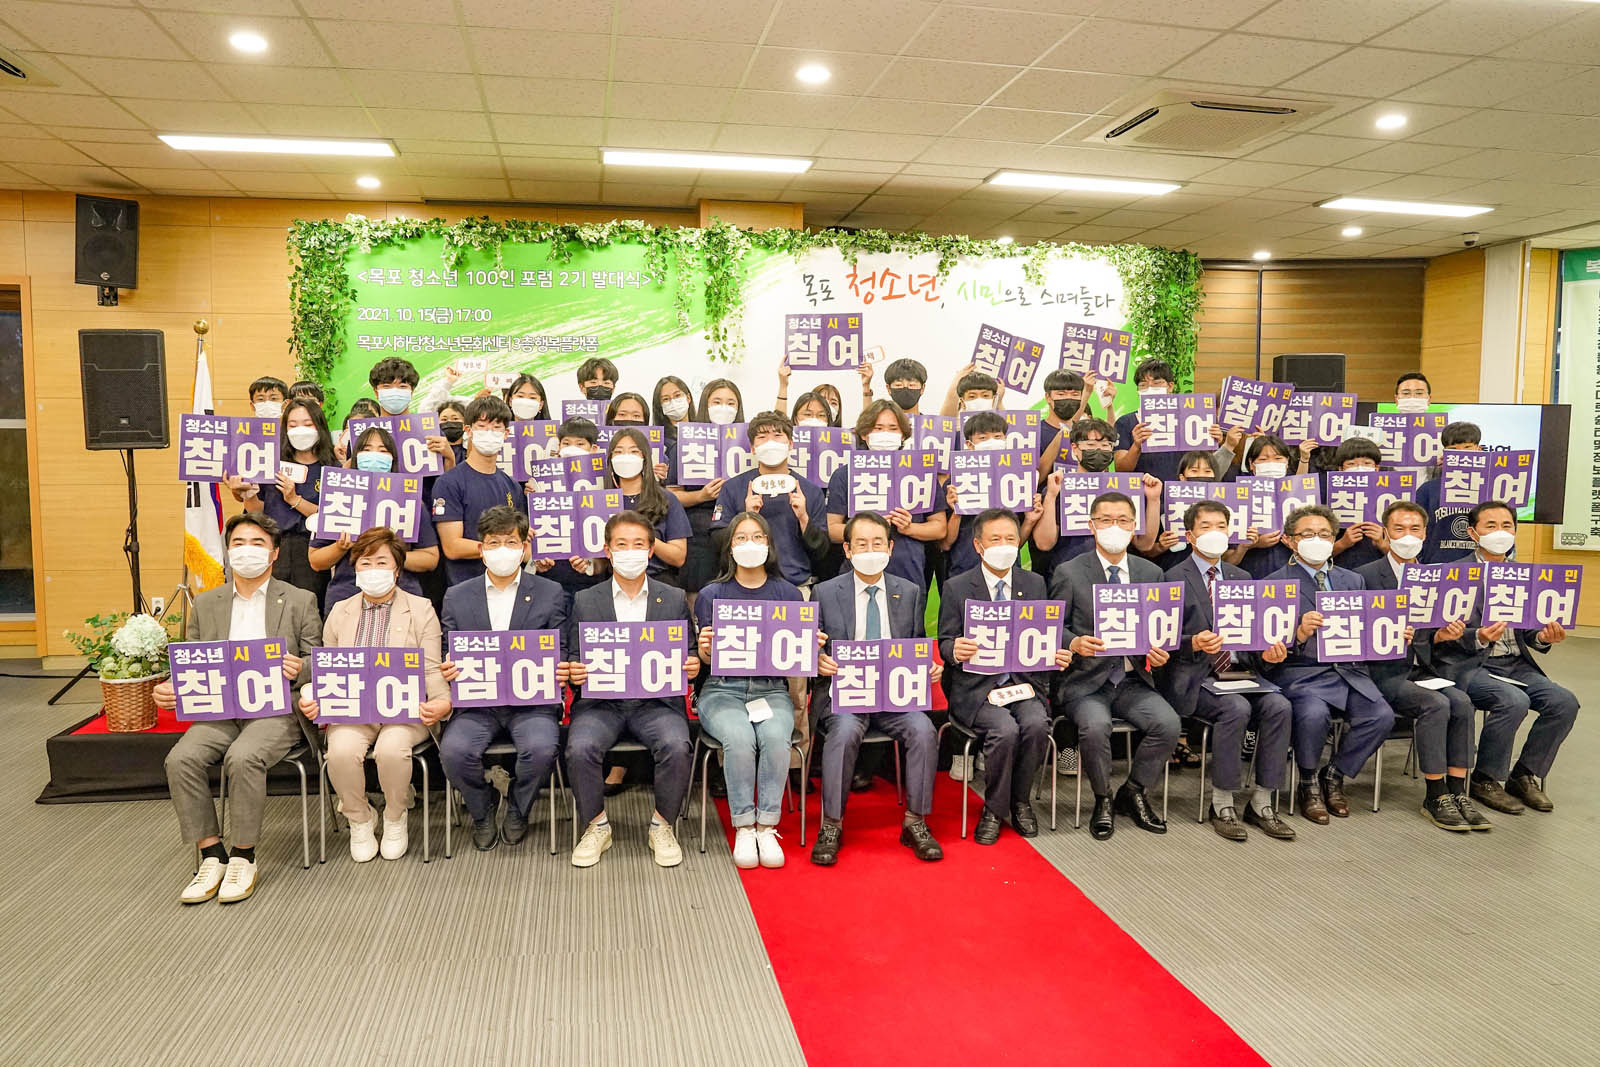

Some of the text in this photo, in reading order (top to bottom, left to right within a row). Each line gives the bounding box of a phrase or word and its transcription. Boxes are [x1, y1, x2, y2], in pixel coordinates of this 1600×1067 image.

[356, 267, 652, 289] <목포 청소년 100인 포럼 2기 발대식>
[803, 264, 1115, 317] 목포 청소년, 시민으로 스며들다
[357, 307, 492, 324] 2021. 10. 15(금) 17:00
[788, 317, 822, 330] 청소년
[982, 328, 1010, 347] 청소년
[1066, 326, 1098, 340] 청소년
[787, 333, 859, 367] 참여
[974, 343, 1037, 391] 참여
[1062, 340, 1127, 380] 참여
[1231, 380, 1264, 396] 청소년
[565, 403, 599, 415] 청소년
[1143, 397, 1178, 410] 청소년
[1289, 395, 1313, 407] 소년
[1223, 394, 1287, 433] 참여
[1373, 415, 1407, 428] 청소년
[185, 419, 228, 435] 청소년
[682, 426, 718, 440] 청소년
[1144, 413, 1215, 448] 참여
[1282, 409, 1352, 443] 참여
[184, 437, 275, 481] 참여
[853, 455, 892, 469] 청소년
[954, 454, 991, 468] 청소년
[1446, 455, 1486, 468] 청소년
[531, 462, 565, 477] 청소년
[326, 471, 369, 490] 청소년
[1064, 477, 1100, 490] 청소년
[1331, 475, 1369, 488] 청소년
[1444, 469, 1528, 505] 참여
[852, 471, 934, 511] 참여
[955, 471, 1032, 510] 참여
[1168, 485, 1206, 498] 청소년
[532, 492, 574, 511] 청소년
[322, 491, 417, 538] 참여
[1406, 566, 1441, 583] 청소년
[1490, 566, 1530, 582] 청소년
[1098, 588, 1139, 604] 청소년
[1218, 584, 1255, 600] 청소년
[1320, 595, 1363, 611] 청소년
[1408, 584, 1478, 623] 참여
[1488, 585, 1576, 626] 참여
[717, 604, 762, 621] 청소년
[969, 605, 1011, 621] 청소년
[1099, 607, 1180, 649] 참여
[1217, 603, 1296, 645] 참여
[453, 635, 501, 652] 청소년
[583, 627, 630, 644] 청소년
[1322, 615, 1407, 657] 참여
[716, 625, 813, 673] 참여
[836, 645, 880, 661] 청소년
[968, 625, 1058, 668] 참여
[174, 647, 224, 665] 청소년
[316, 652, 365, 668] 청소년
[454, 656, 555, 701] 참여
[584, 647, 683, 693] 참여
[177, 666, 286, 714] 참여
[836, 664, 928, 708] 참여
[316, 672, 420, 719] 참여
